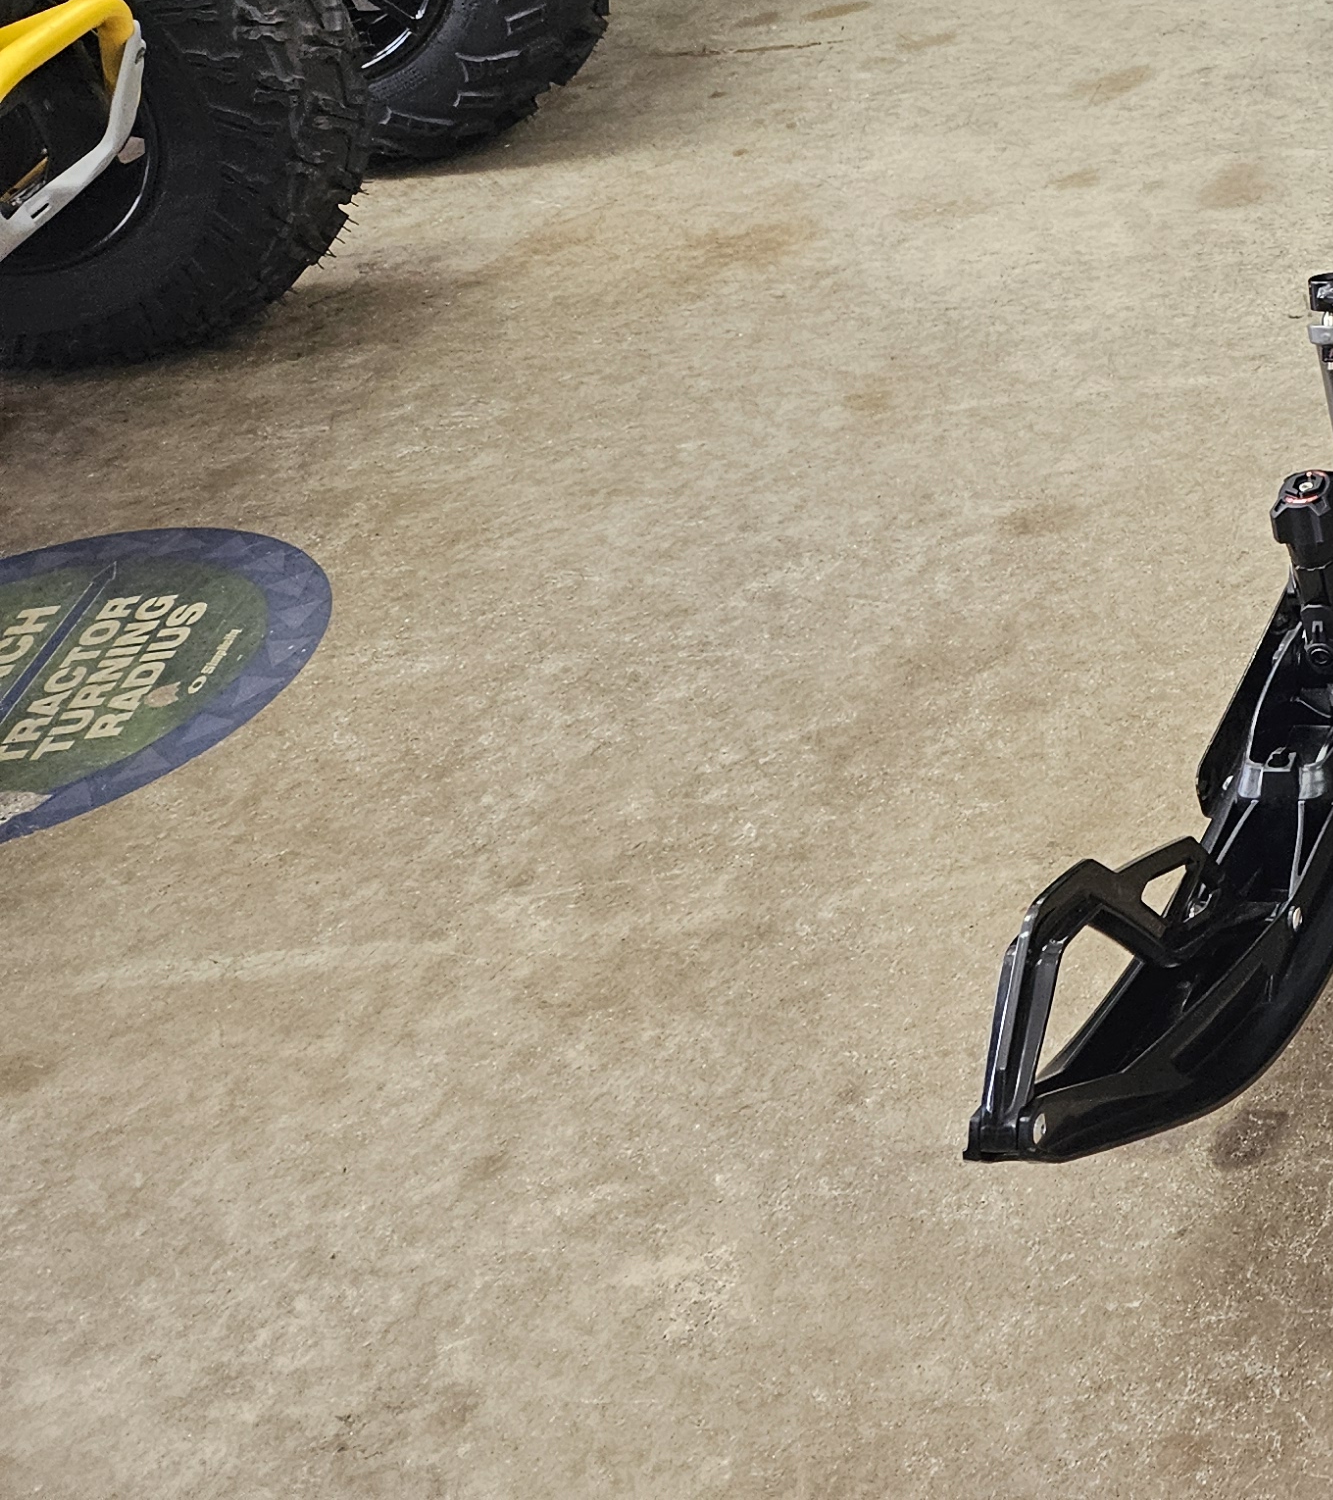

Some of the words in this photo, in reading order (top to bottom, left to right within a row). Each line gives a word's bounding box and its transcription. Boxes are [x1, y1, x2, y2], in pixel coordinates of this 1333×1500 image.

[0, 594, 143, 761] TRACTOR
[29, 593, 179, 761] TURNING
[84, 601, 207, 740] RADIUS
